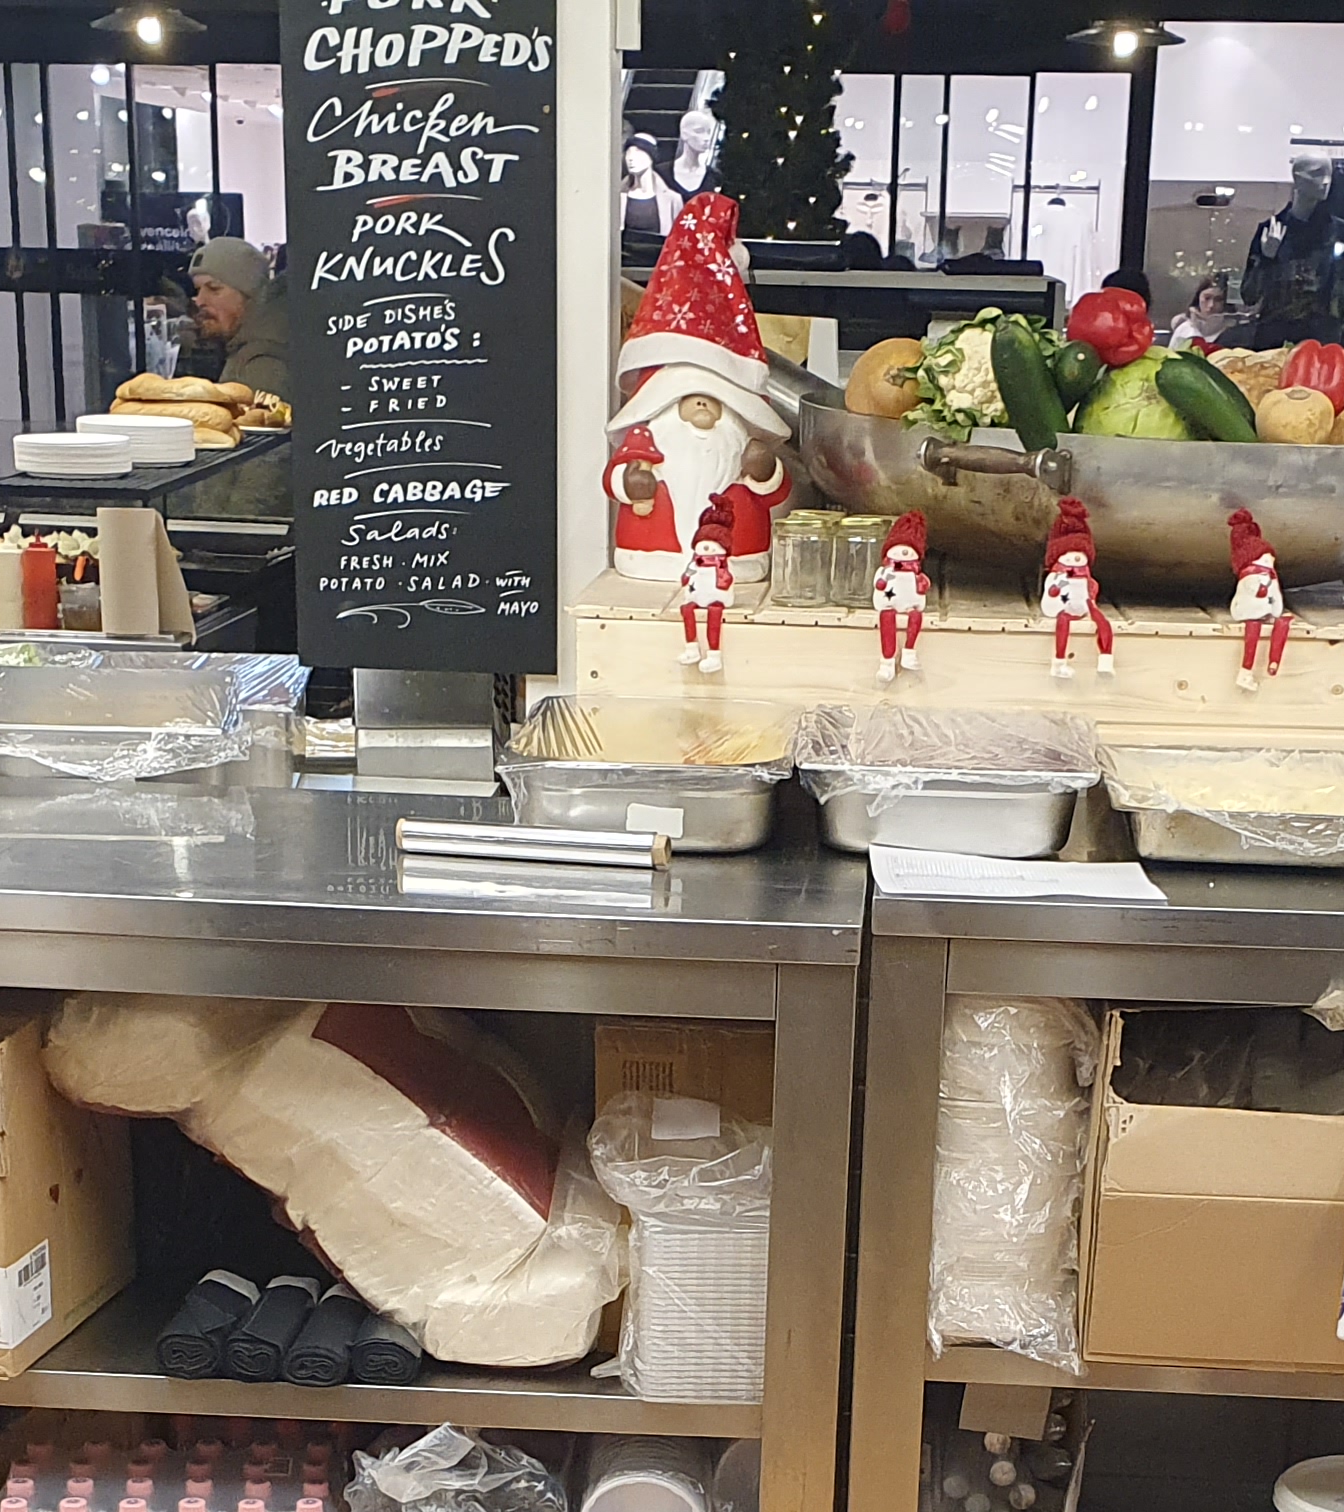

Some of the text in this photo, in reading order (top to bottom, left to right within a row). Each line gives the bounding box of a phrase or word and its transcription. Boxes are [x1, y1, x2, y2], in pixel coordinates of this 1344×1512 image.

[304, 23, 552, 74] CHOPPED'S
[306, 93, 539, 154] Chicken
[314, 147, 519, 191] BREAST
[351, 211, 472, 247] PORK
[310, 227, 516, 290] KNUCKLES
[326, 313, 371, 335] SIDE
[368, 375, 442, 392] SWEET
[369, 395, 447, 413] FRIED
[316, 431, 443, 462] vegetables
[313, 479, 511, 508] RED CABBAGE
[341, 551, 450, 570] FRESH MIX
[320, 574, 531, 592] POTATO SALAD WITH
[497, 600, 539, 615] MAYO
